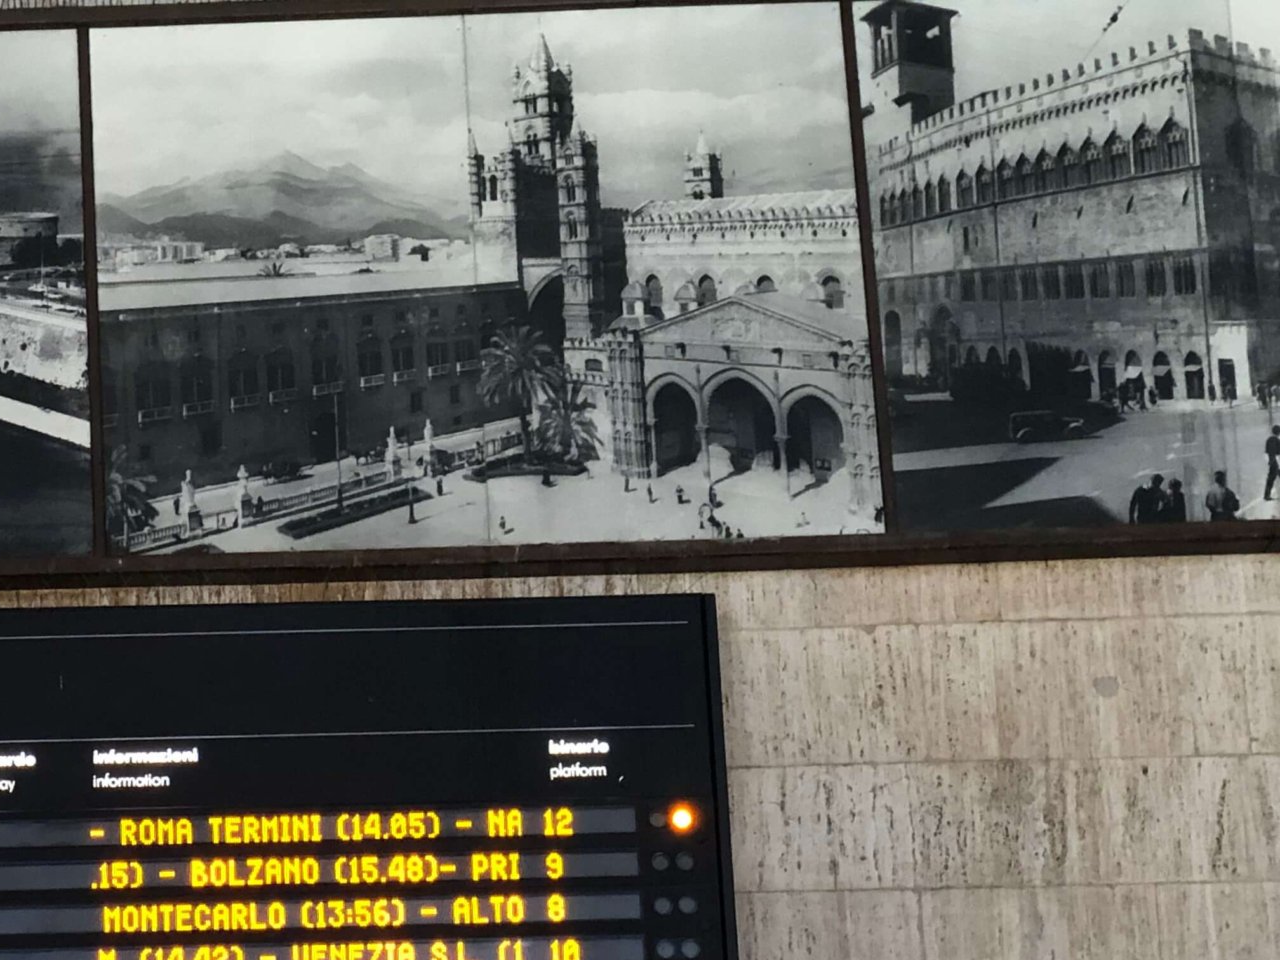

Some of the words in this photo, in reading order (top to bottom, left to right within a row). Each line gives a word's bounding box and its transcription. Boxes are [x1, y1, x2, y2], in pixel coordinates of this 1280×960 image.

[92, 772, 171, 789] information
[549, 761, 608, 781] platform
[120, 818, 193, 846] ROMA
[208, 814, 322, 844] TERMINI
[337, 812, 440, 841] (14.05)
[487, 809, 522, 837] NA
[543, 808, 573, 836] 12
[91, 861, 143, 889] .15)
[190, 857, 319, 887] BOLZANO
[472, 853, 520, 881] PRI
[546, 852, 563, 879] 9
[103, 902, 286, 933] MONTECARLO
[453, 895, 524, 924] ALTO
[547, 894, 566, 922] 8
